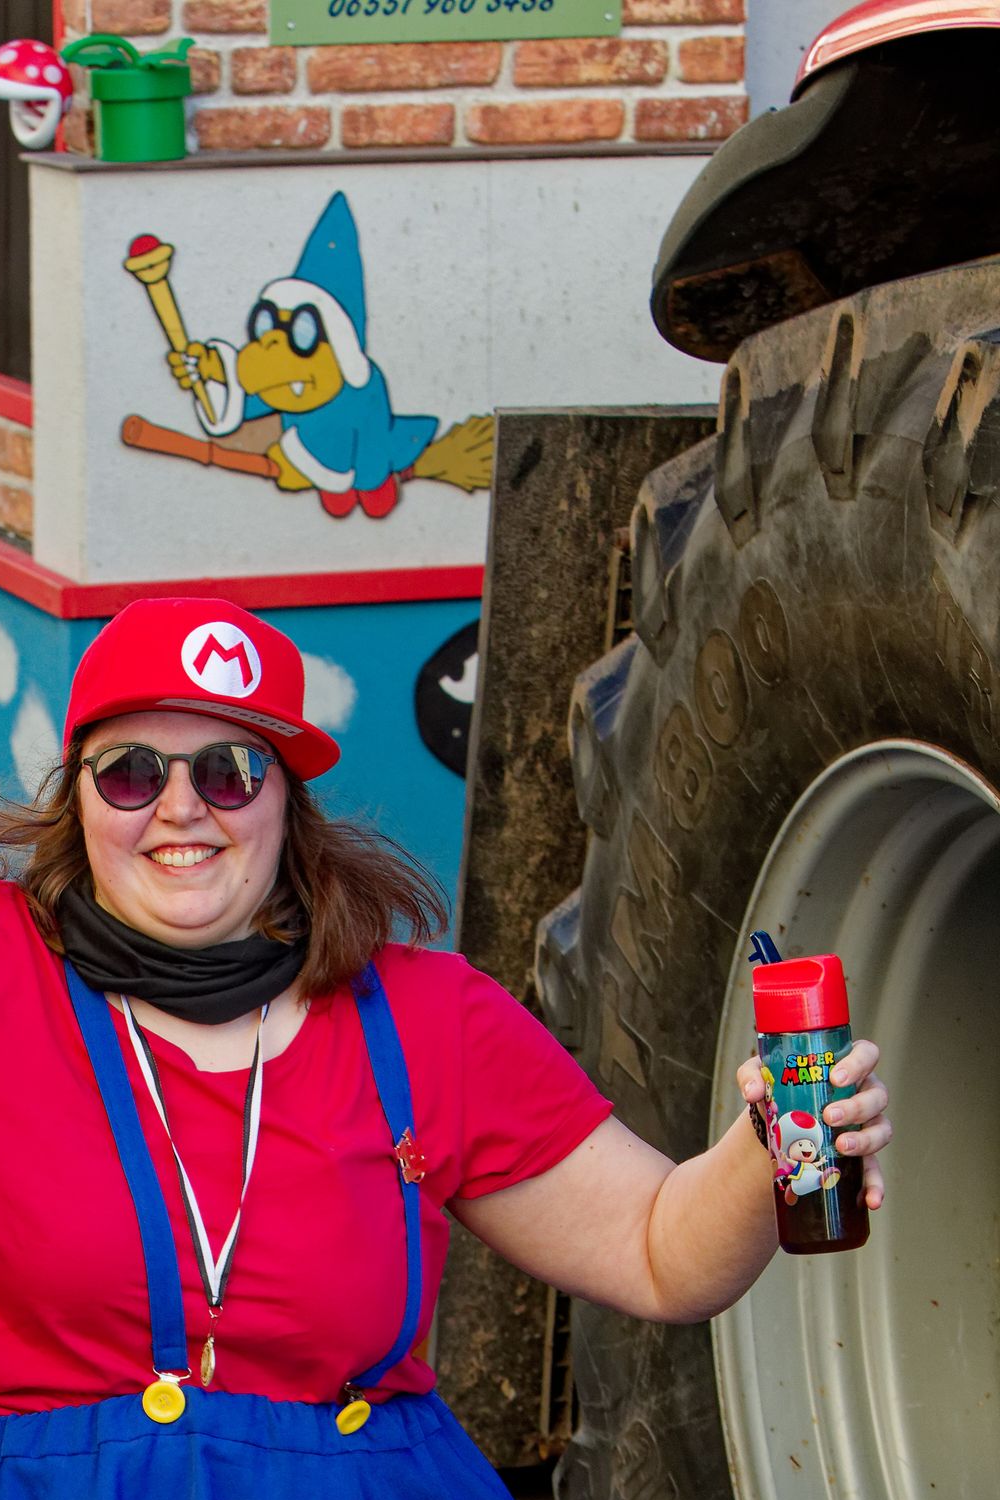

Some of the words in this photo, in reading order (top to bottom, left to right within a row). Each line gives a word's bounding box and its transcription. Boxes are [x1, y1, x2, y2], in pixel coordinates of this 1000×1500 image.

[193, 632, 254, 689] M
[786, 1050, 836, 1068] SUPER
[781, 1065, 835, 1087] MARI
